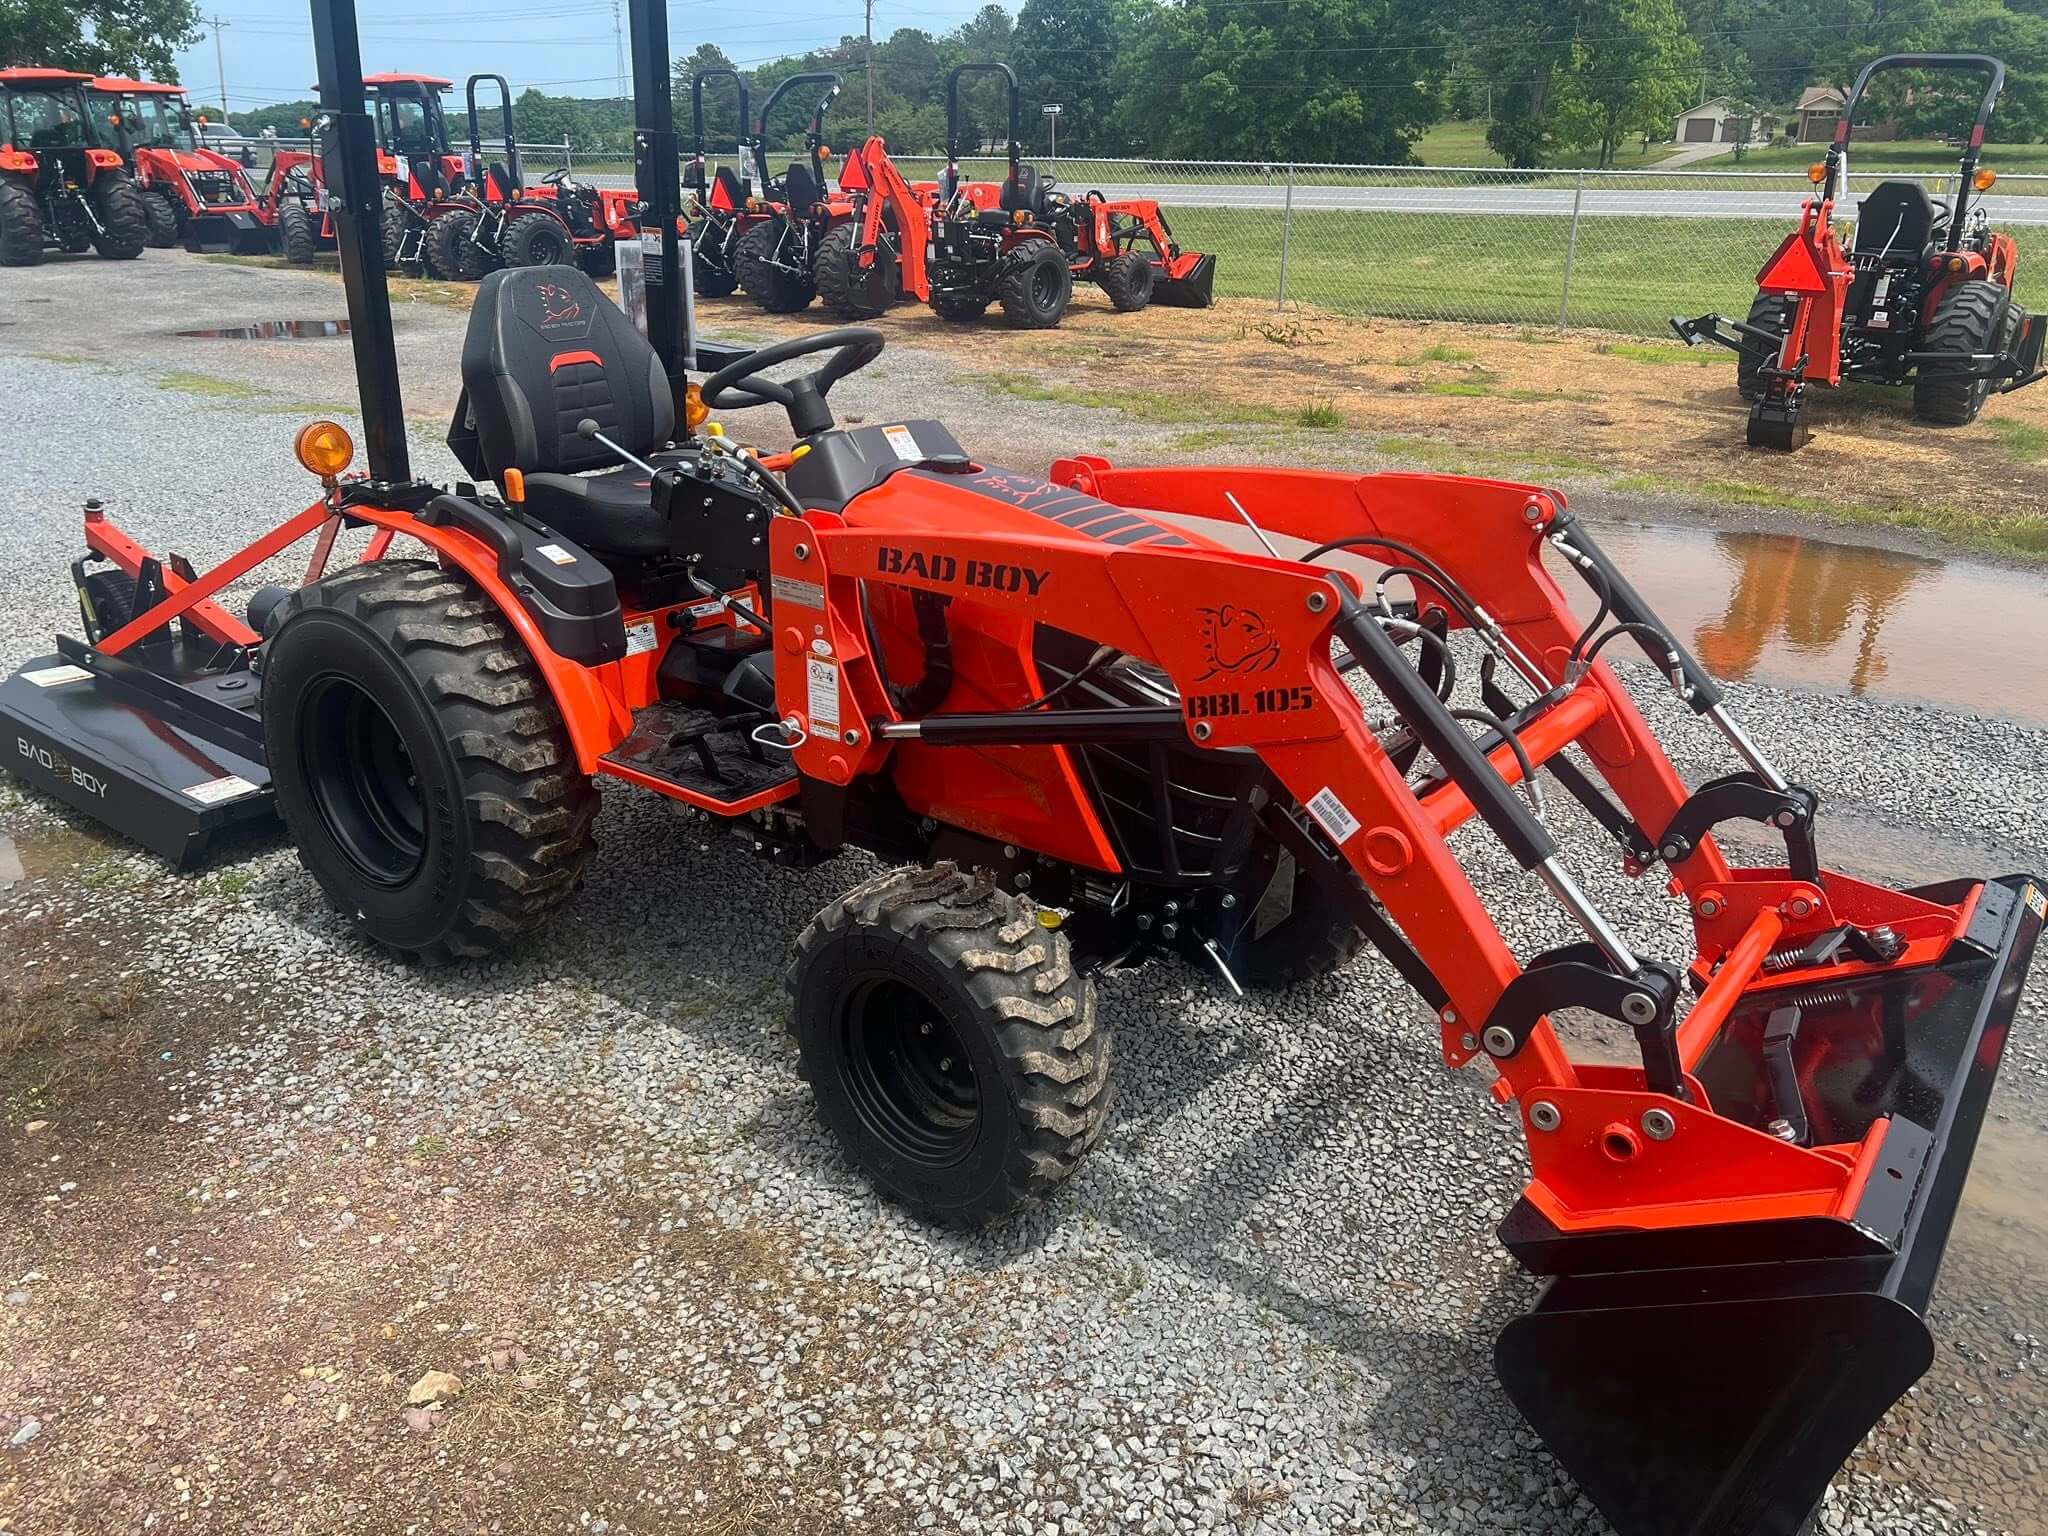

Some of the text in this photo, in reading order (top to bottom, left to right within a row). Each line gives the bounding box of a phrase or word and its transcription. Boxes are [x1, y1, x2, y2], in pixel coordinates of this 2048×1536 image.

[877, 547, 1051, 596] BAD BOY
[1188, 686, 1312, 719] BBL 105
[17, 736, 108, 798] BAD BOY
